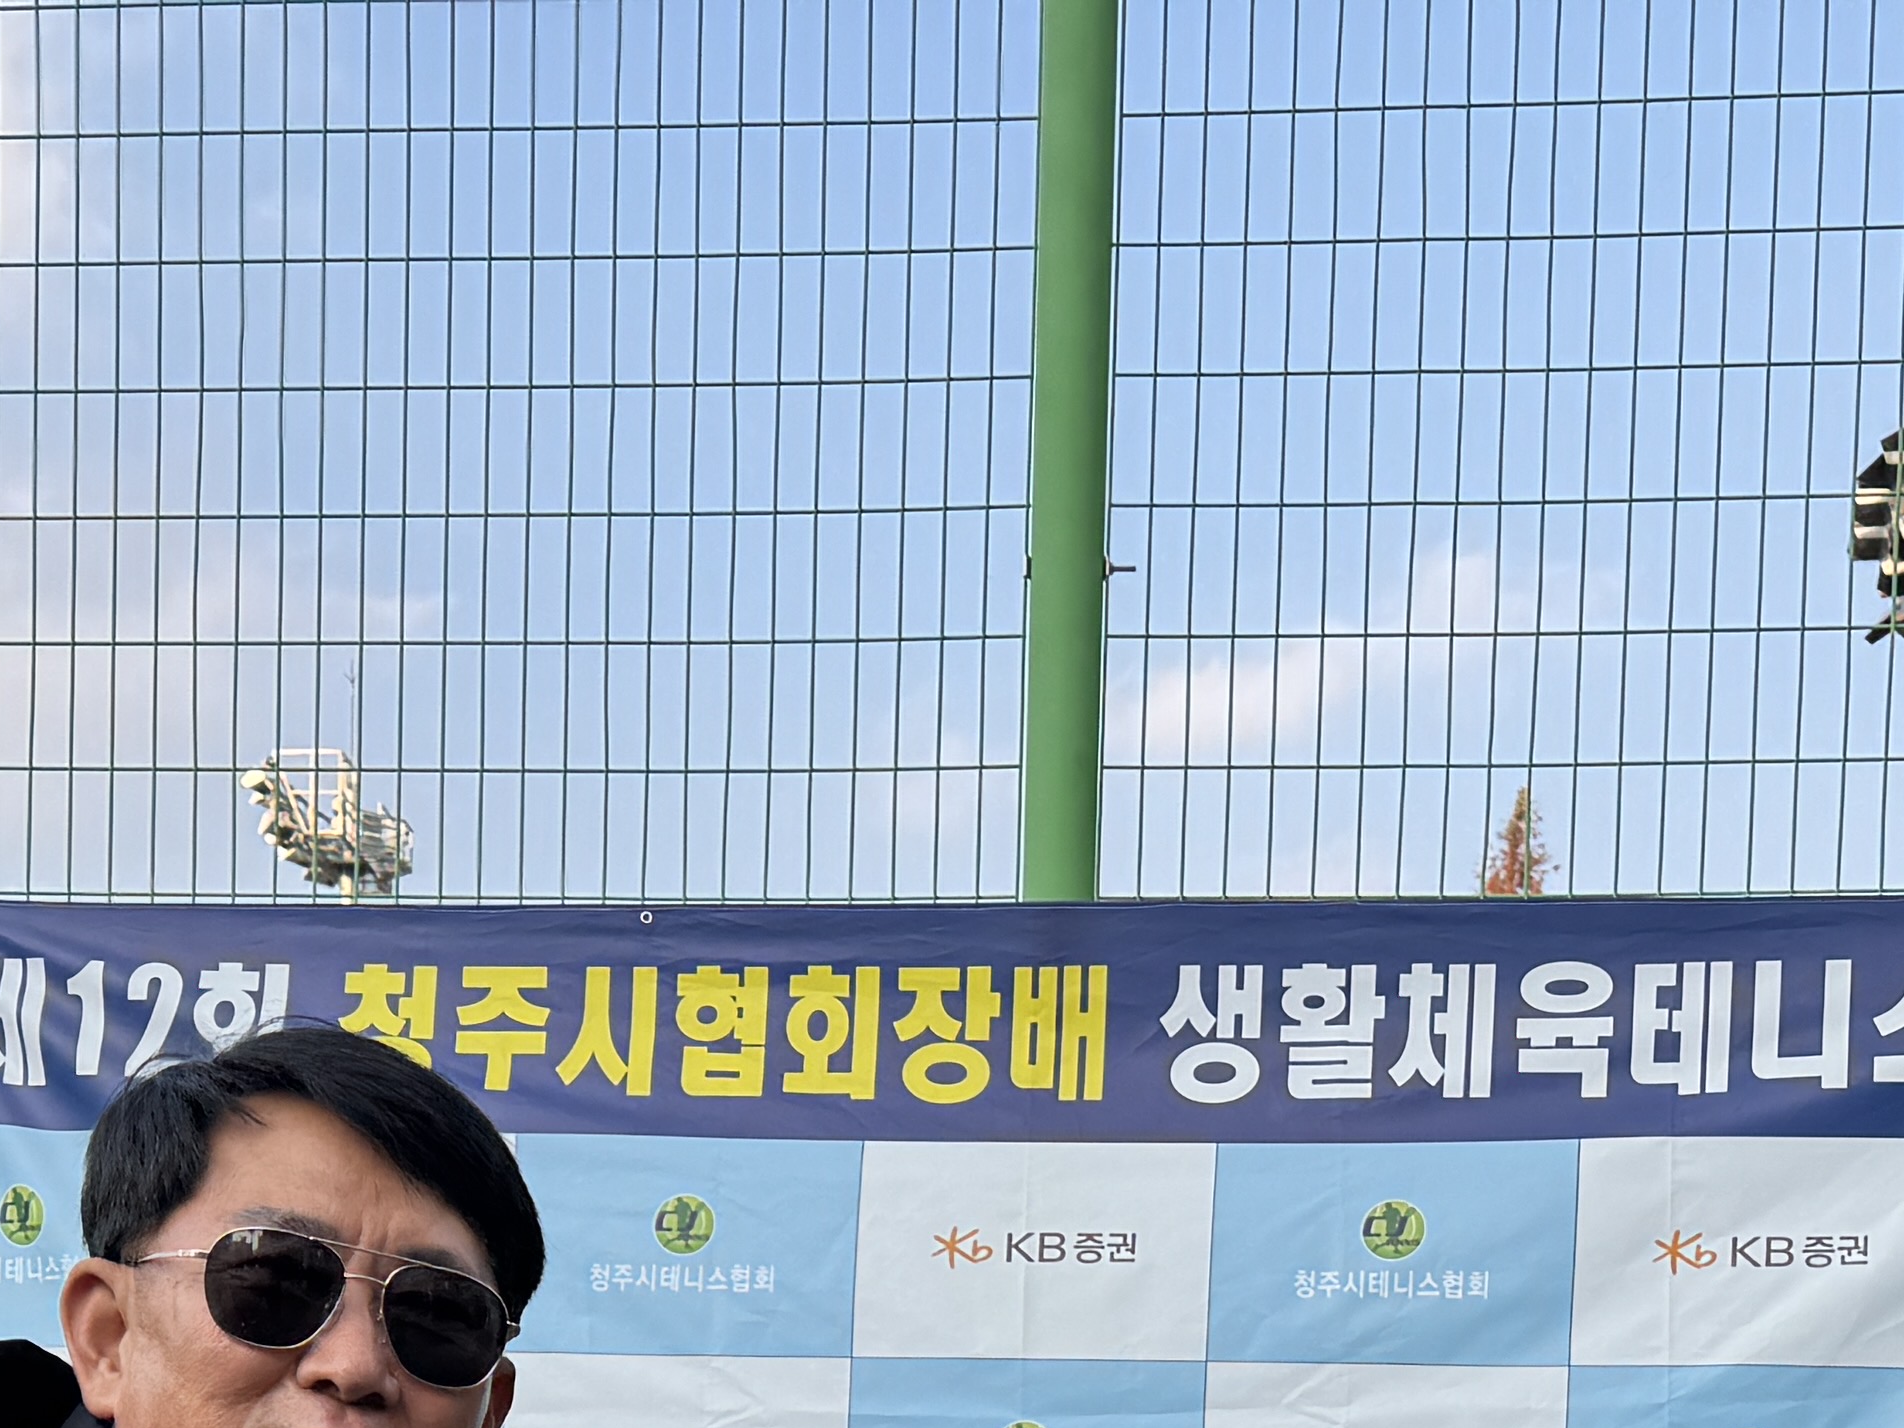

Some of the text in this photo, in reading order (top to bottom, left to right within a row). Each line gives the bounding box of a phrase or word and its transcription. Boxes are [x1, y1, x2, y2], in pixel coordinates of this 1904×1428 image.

[339, 963, 1108, 1104] 청주시협회장배
[590, 1263, 775, 1292] 청주시테니스협회
[1294, 1269, 1488, 1300] 청주시테니스협회
